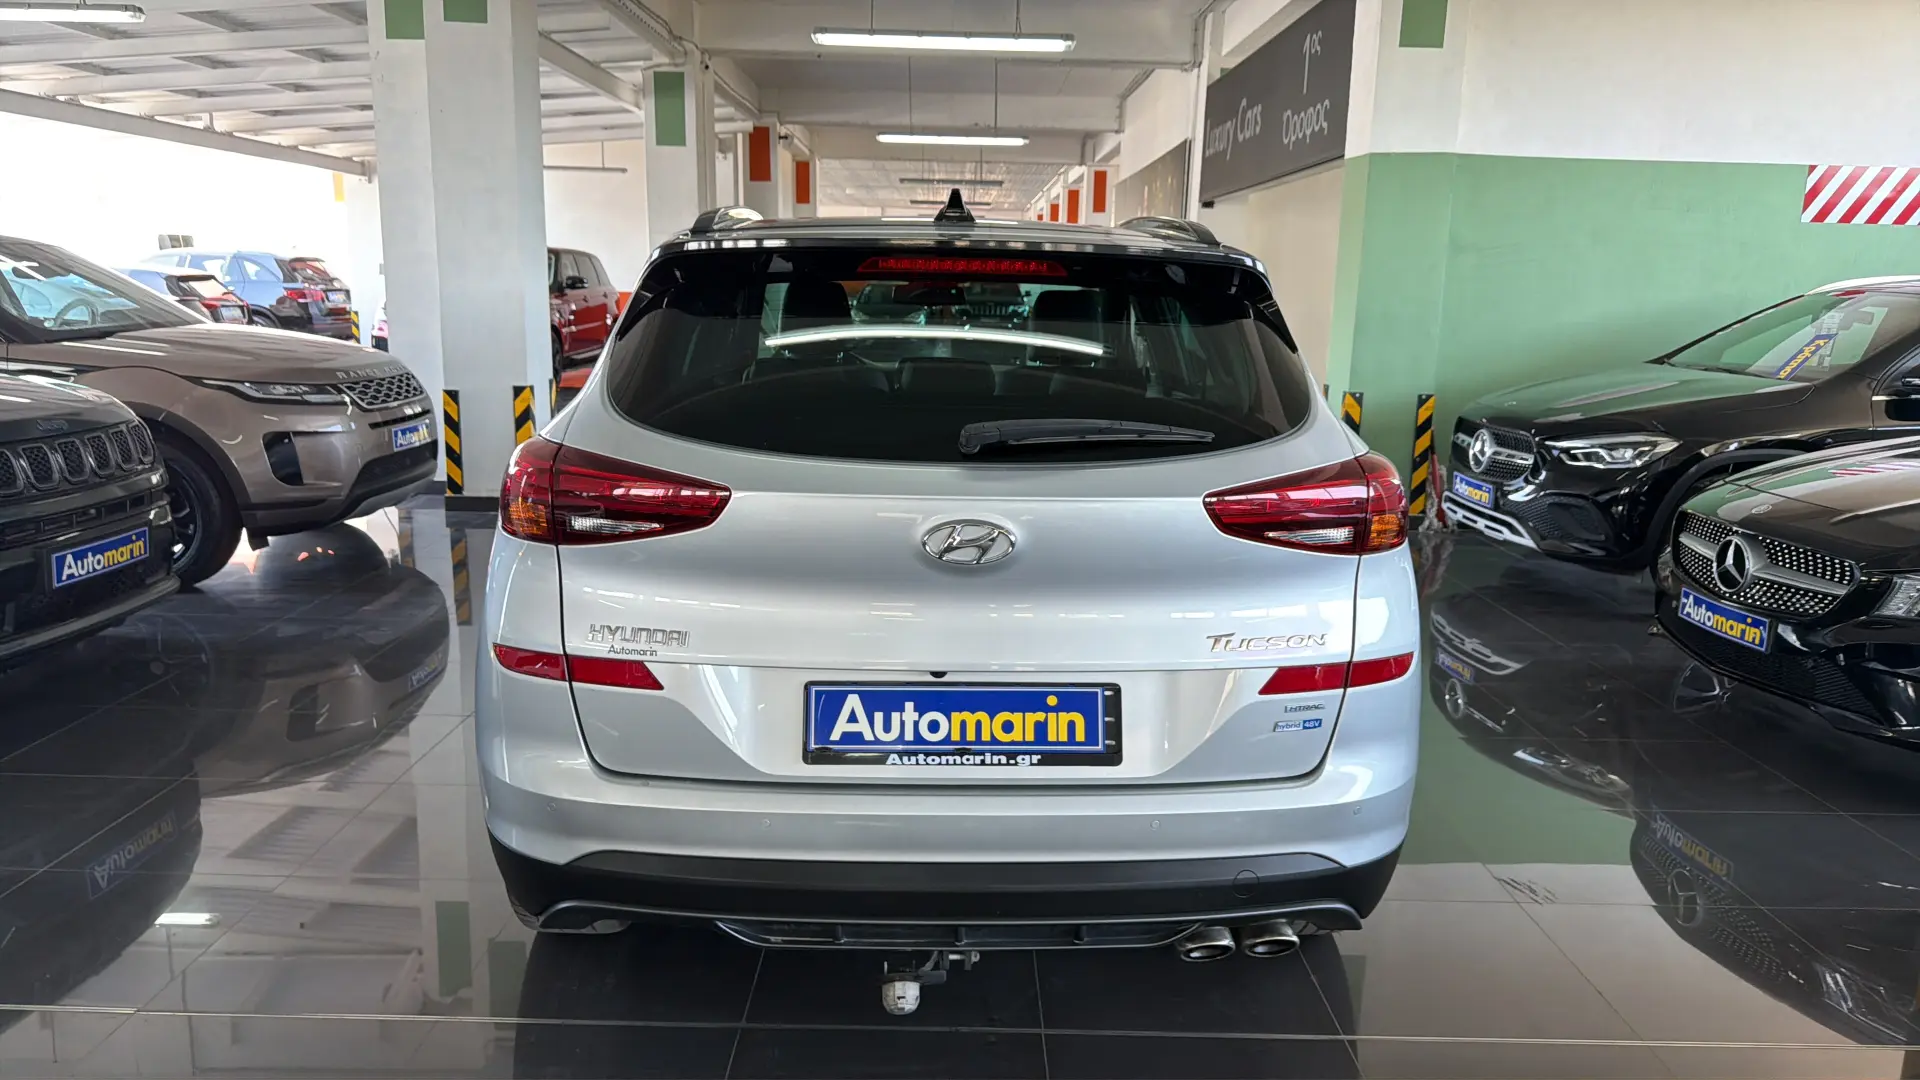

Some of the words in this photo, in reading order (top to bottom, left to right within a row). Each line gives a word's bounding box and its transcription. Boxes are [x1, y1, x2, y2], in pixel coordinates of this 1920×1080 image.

[1205, 118, 1236, 161] Luxury
[1237, 97, 1262, 143] Cars
[61, 535, 145, 581] Automarin
[1683, 594, 1761, 645] Automarin
[588, 623, 690, 648] HYUNDAI
[1206, 632, 1327, 652] TUCSON
[607, 644, 658, 657] Automarin
[829, 693, 1085, 742] Automarin
[1276, 721, 1301, 731] hybrid
[1303, 720, 1320, 728] 48V
[885, 752, 1041, 767] Automarin.gr
